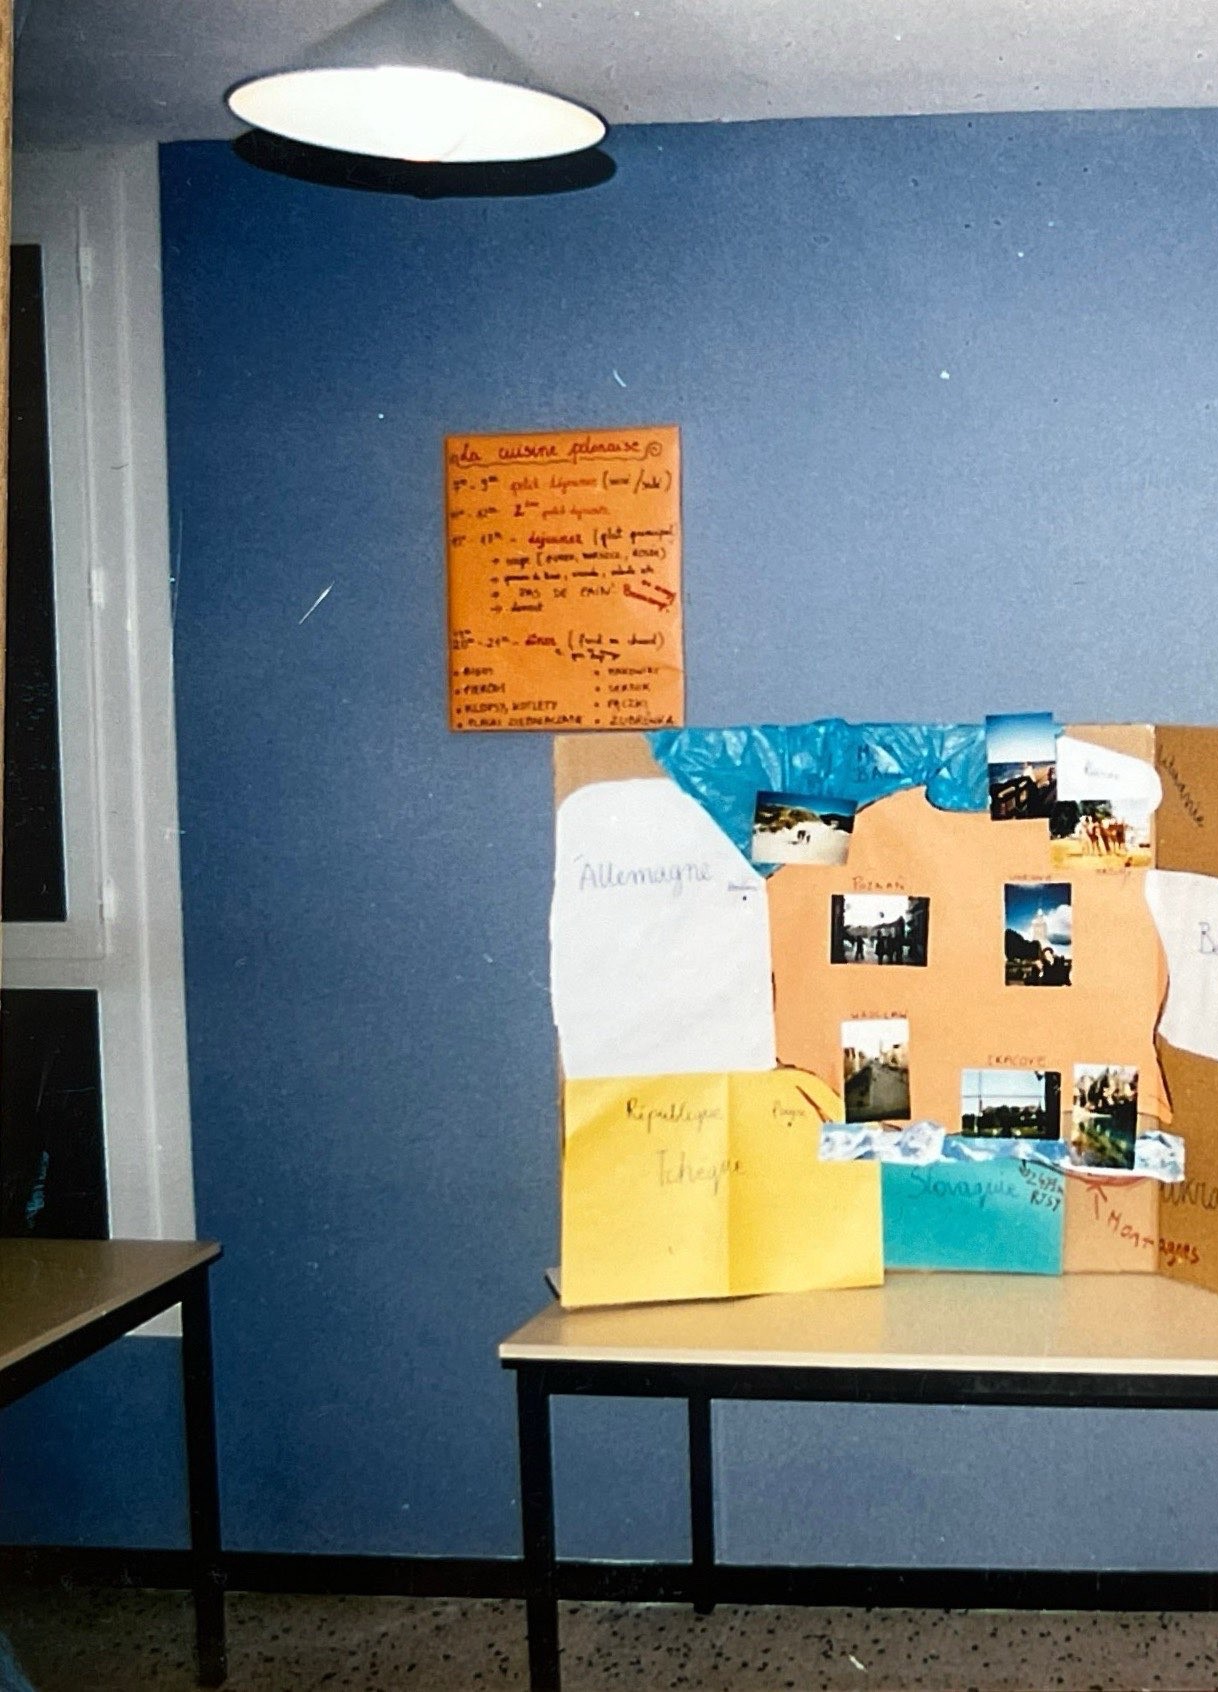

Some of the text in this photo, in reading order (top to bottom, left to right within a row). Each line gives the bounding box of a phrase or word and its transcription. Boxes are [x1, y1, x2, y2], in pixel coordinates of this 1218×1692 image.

[460, 437, 640, 464] La cuisine polonaise
[579, 861, 713, 897] Allemagne
